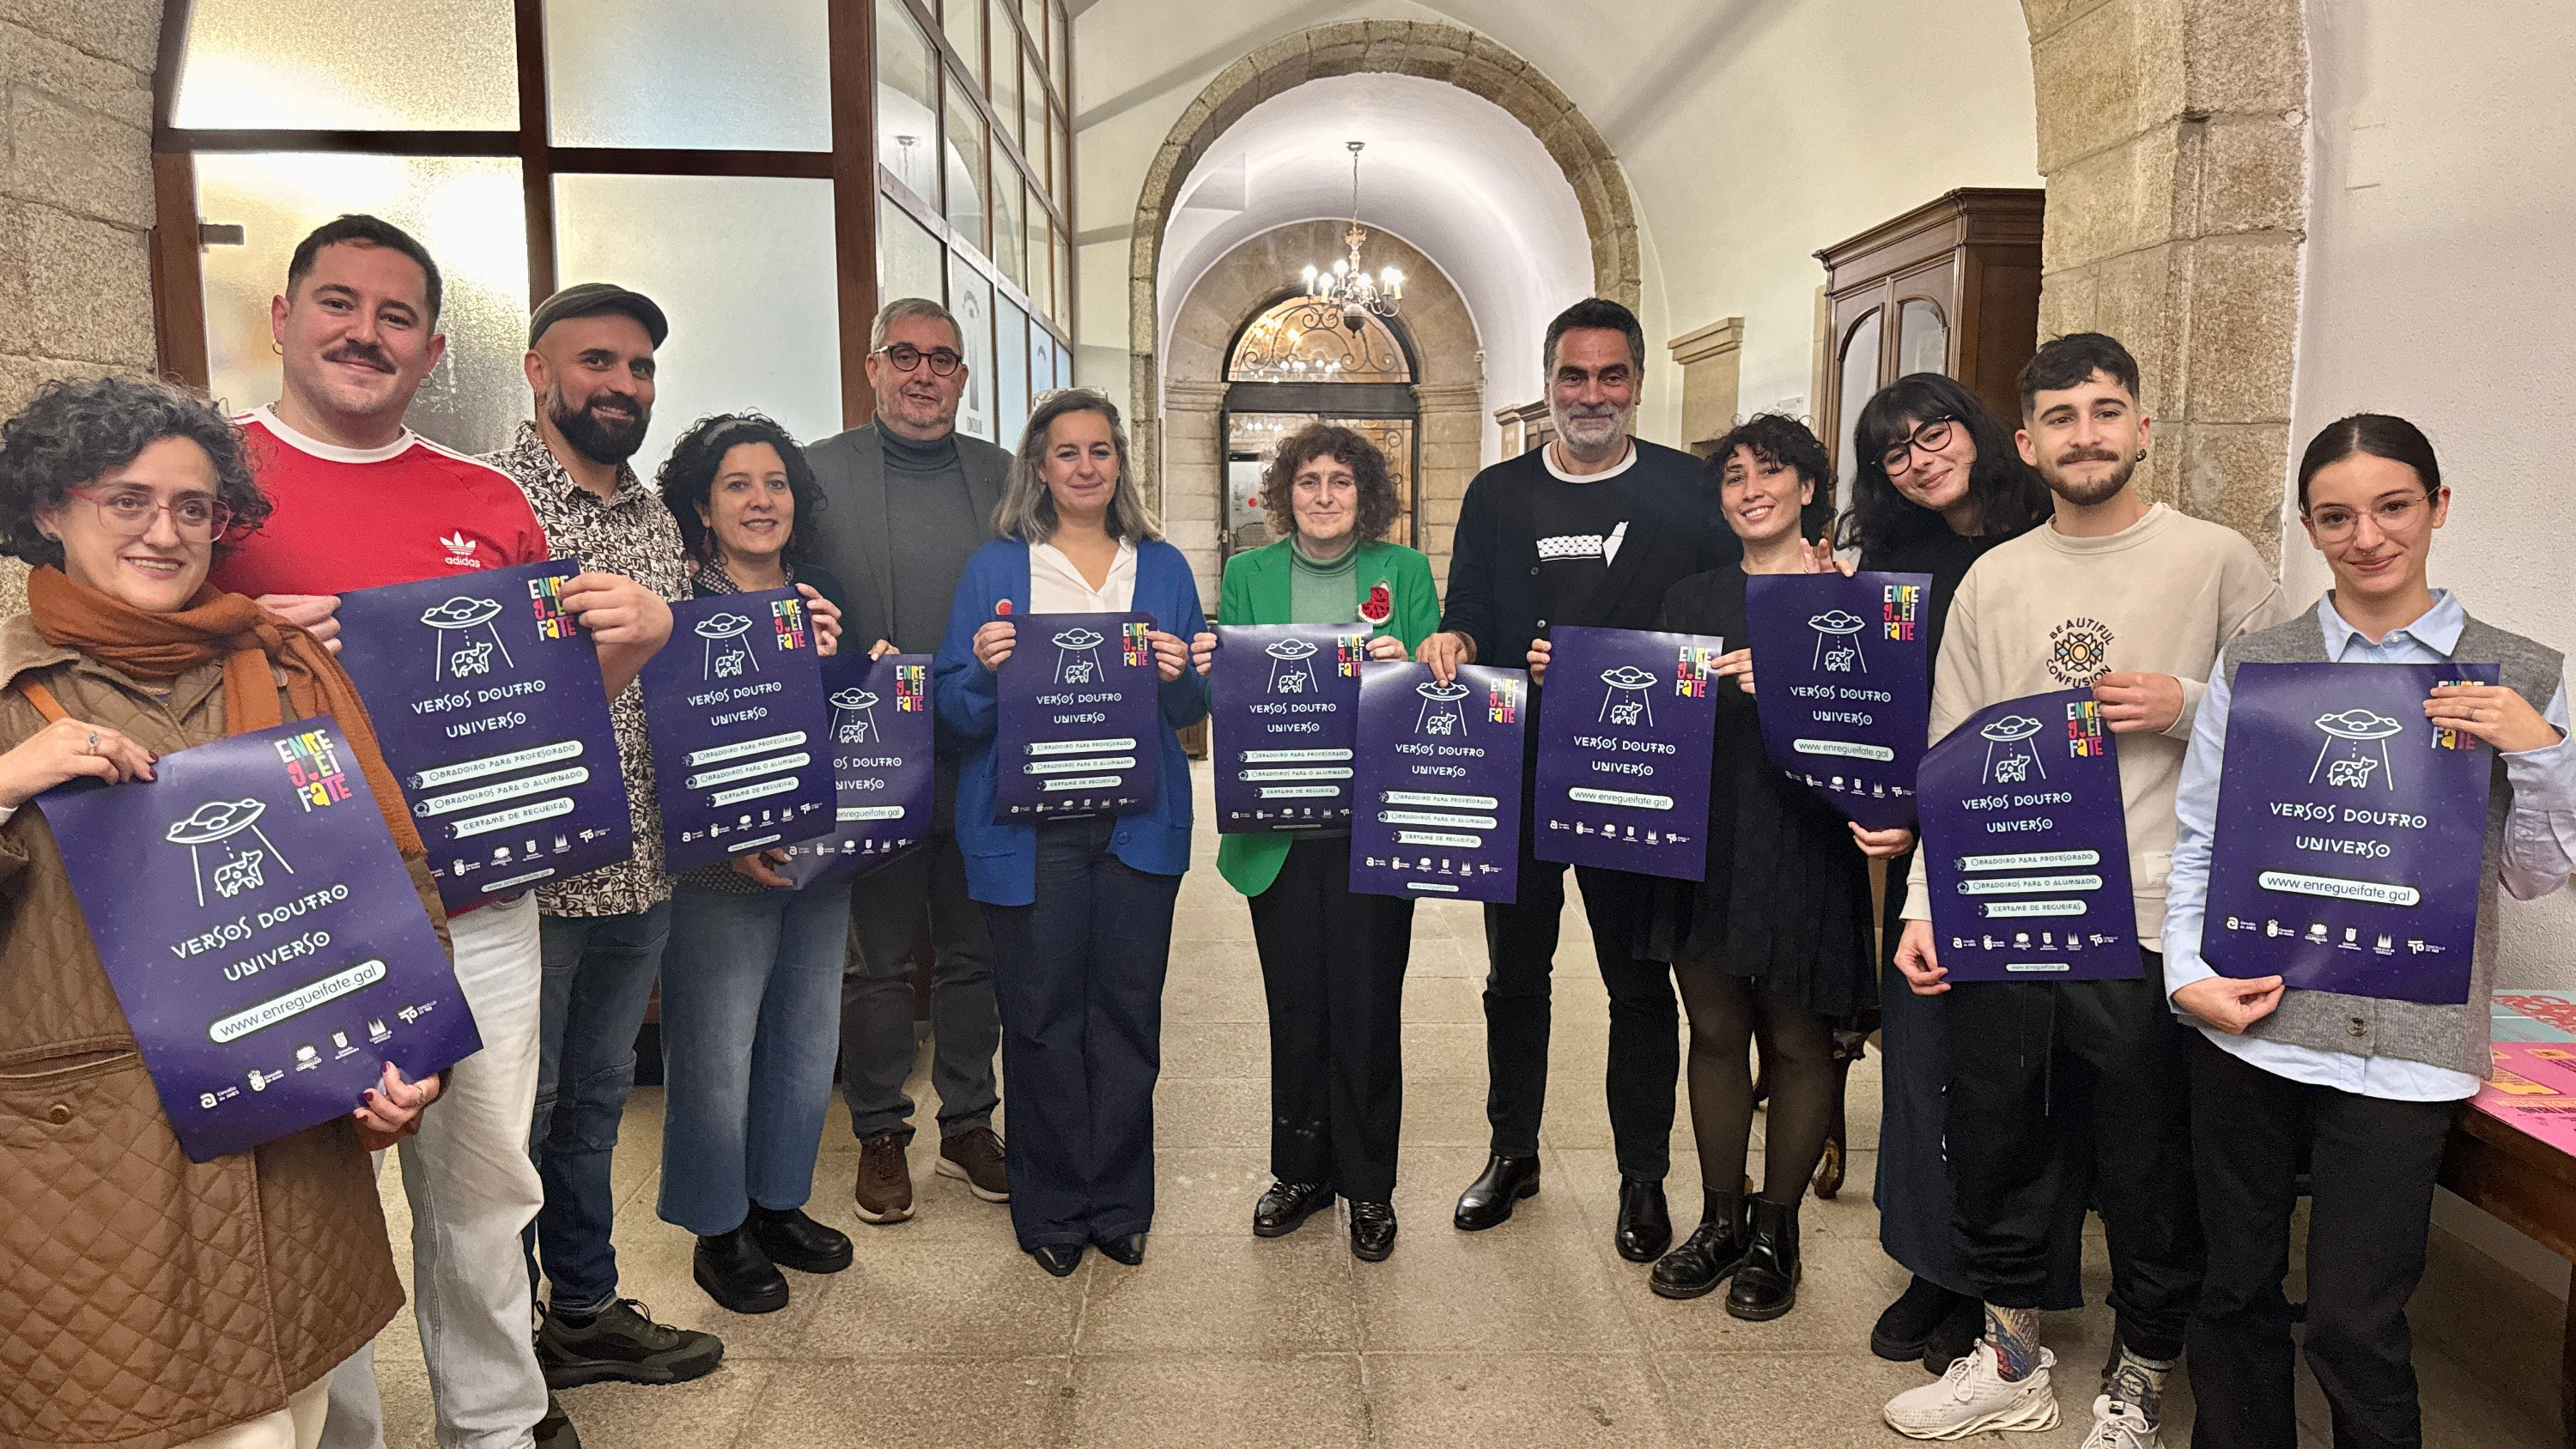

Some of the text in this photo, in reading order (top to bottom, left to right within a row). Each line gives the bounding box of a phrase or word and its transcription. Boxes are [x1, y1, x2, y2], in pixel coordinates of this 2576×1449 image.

[445, 555, 481, 568] adidas
[1883, 585, 1920, 603] ENRE
[771, 598, 801, 617] ENRE
[2049, 617, 2115, 646] BEAUTIFUL
[1337, 634, 1365, 647] ENRE
[1679, 646, 1713, 663] ENRE
[896, 665, 926, 681] ENRE
[686, 681, 781, 706] VERSOS DOUTRO
[1490, 677, 1519, 694] ENRE
[1789, 684, 1891, 702] VERSOS DOUTRO
[410, 679, 545, 714] VERSOS DOUTRO
[1036, 692, 1121, 706] VERSOS DOUTRO
[710, 706, 767, 726] UNIVERSO
[1249, 701, 1336, 714] VERSOS DOUTRO
[446, 712, 526, 737] UNIVERSO
[1053, 711, 1105, 724] UNIVERSO
[1812, 710, 1872, 726] UNIVERSO
[1267, 721, 1320, 733] UNIVERSO
[274, 729, 334, 764] ENRE
[1394, 743, 1485, 757] VERSOS DOUTRO
[1573, 735, 1675, 755] VERSOS DOUTRO
[489, 757, 512, 767] PARA
[852, 756, 902, 767] DOUTRO
[1591, 760, 1654, 777] UNIVERSO
[1412, 765, 1466, 778] UNIVERSO
[496, 784, 519, 794] PARA
[835, 777, 884, 791] NIVERSO
[1961, 791, 2072, 810] VERSOS DOUTRO
[507, 811, 519, 820] DE
[2269, 802, 2427, 828] VERSOS DOUTRO
[1985, 816, 2053, 833] UNIVERSO
[2295, 835, 2391, 858] UNIVERSO
[170, 883, 348, 959] VERSOS DOUTRO
[224, 931, 330, 980] UNIVERSO
